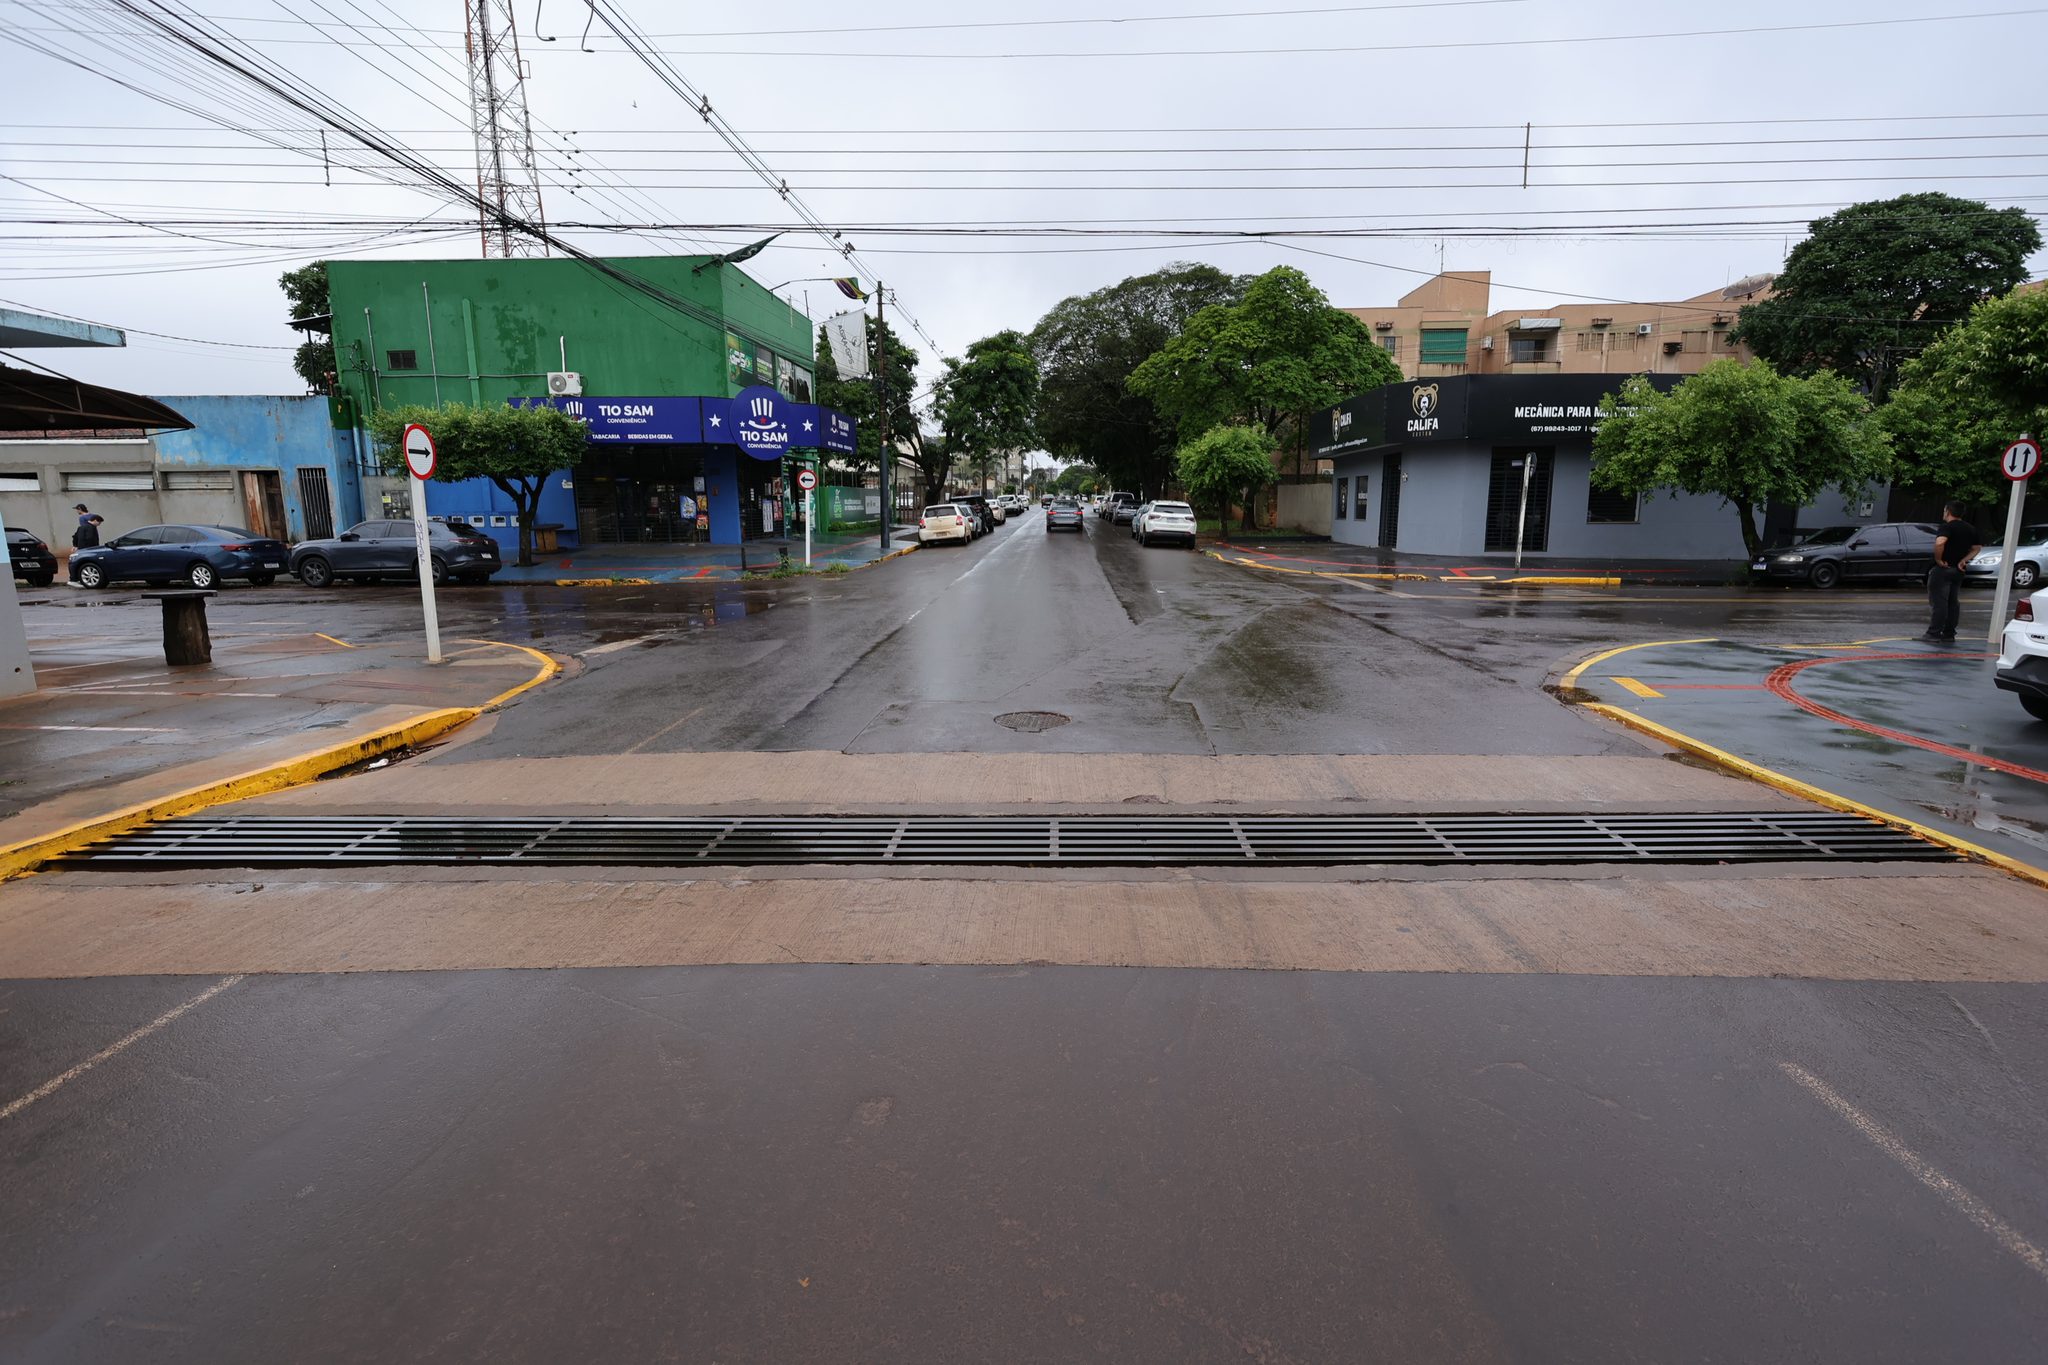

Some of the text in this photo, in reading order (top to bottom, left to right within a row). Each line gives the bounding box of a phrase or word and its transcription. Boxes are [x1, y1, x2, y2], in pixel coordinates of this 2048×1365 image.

[598, 405, 654, 416] TIO SAM
[1514, 403, 1564, 418] MECÂNICA
[1566, 406, 1591, 418] PARA
[1407, 417, 1439, 432] CALIFA
[739, 430, 788, 442] TIO SAM
